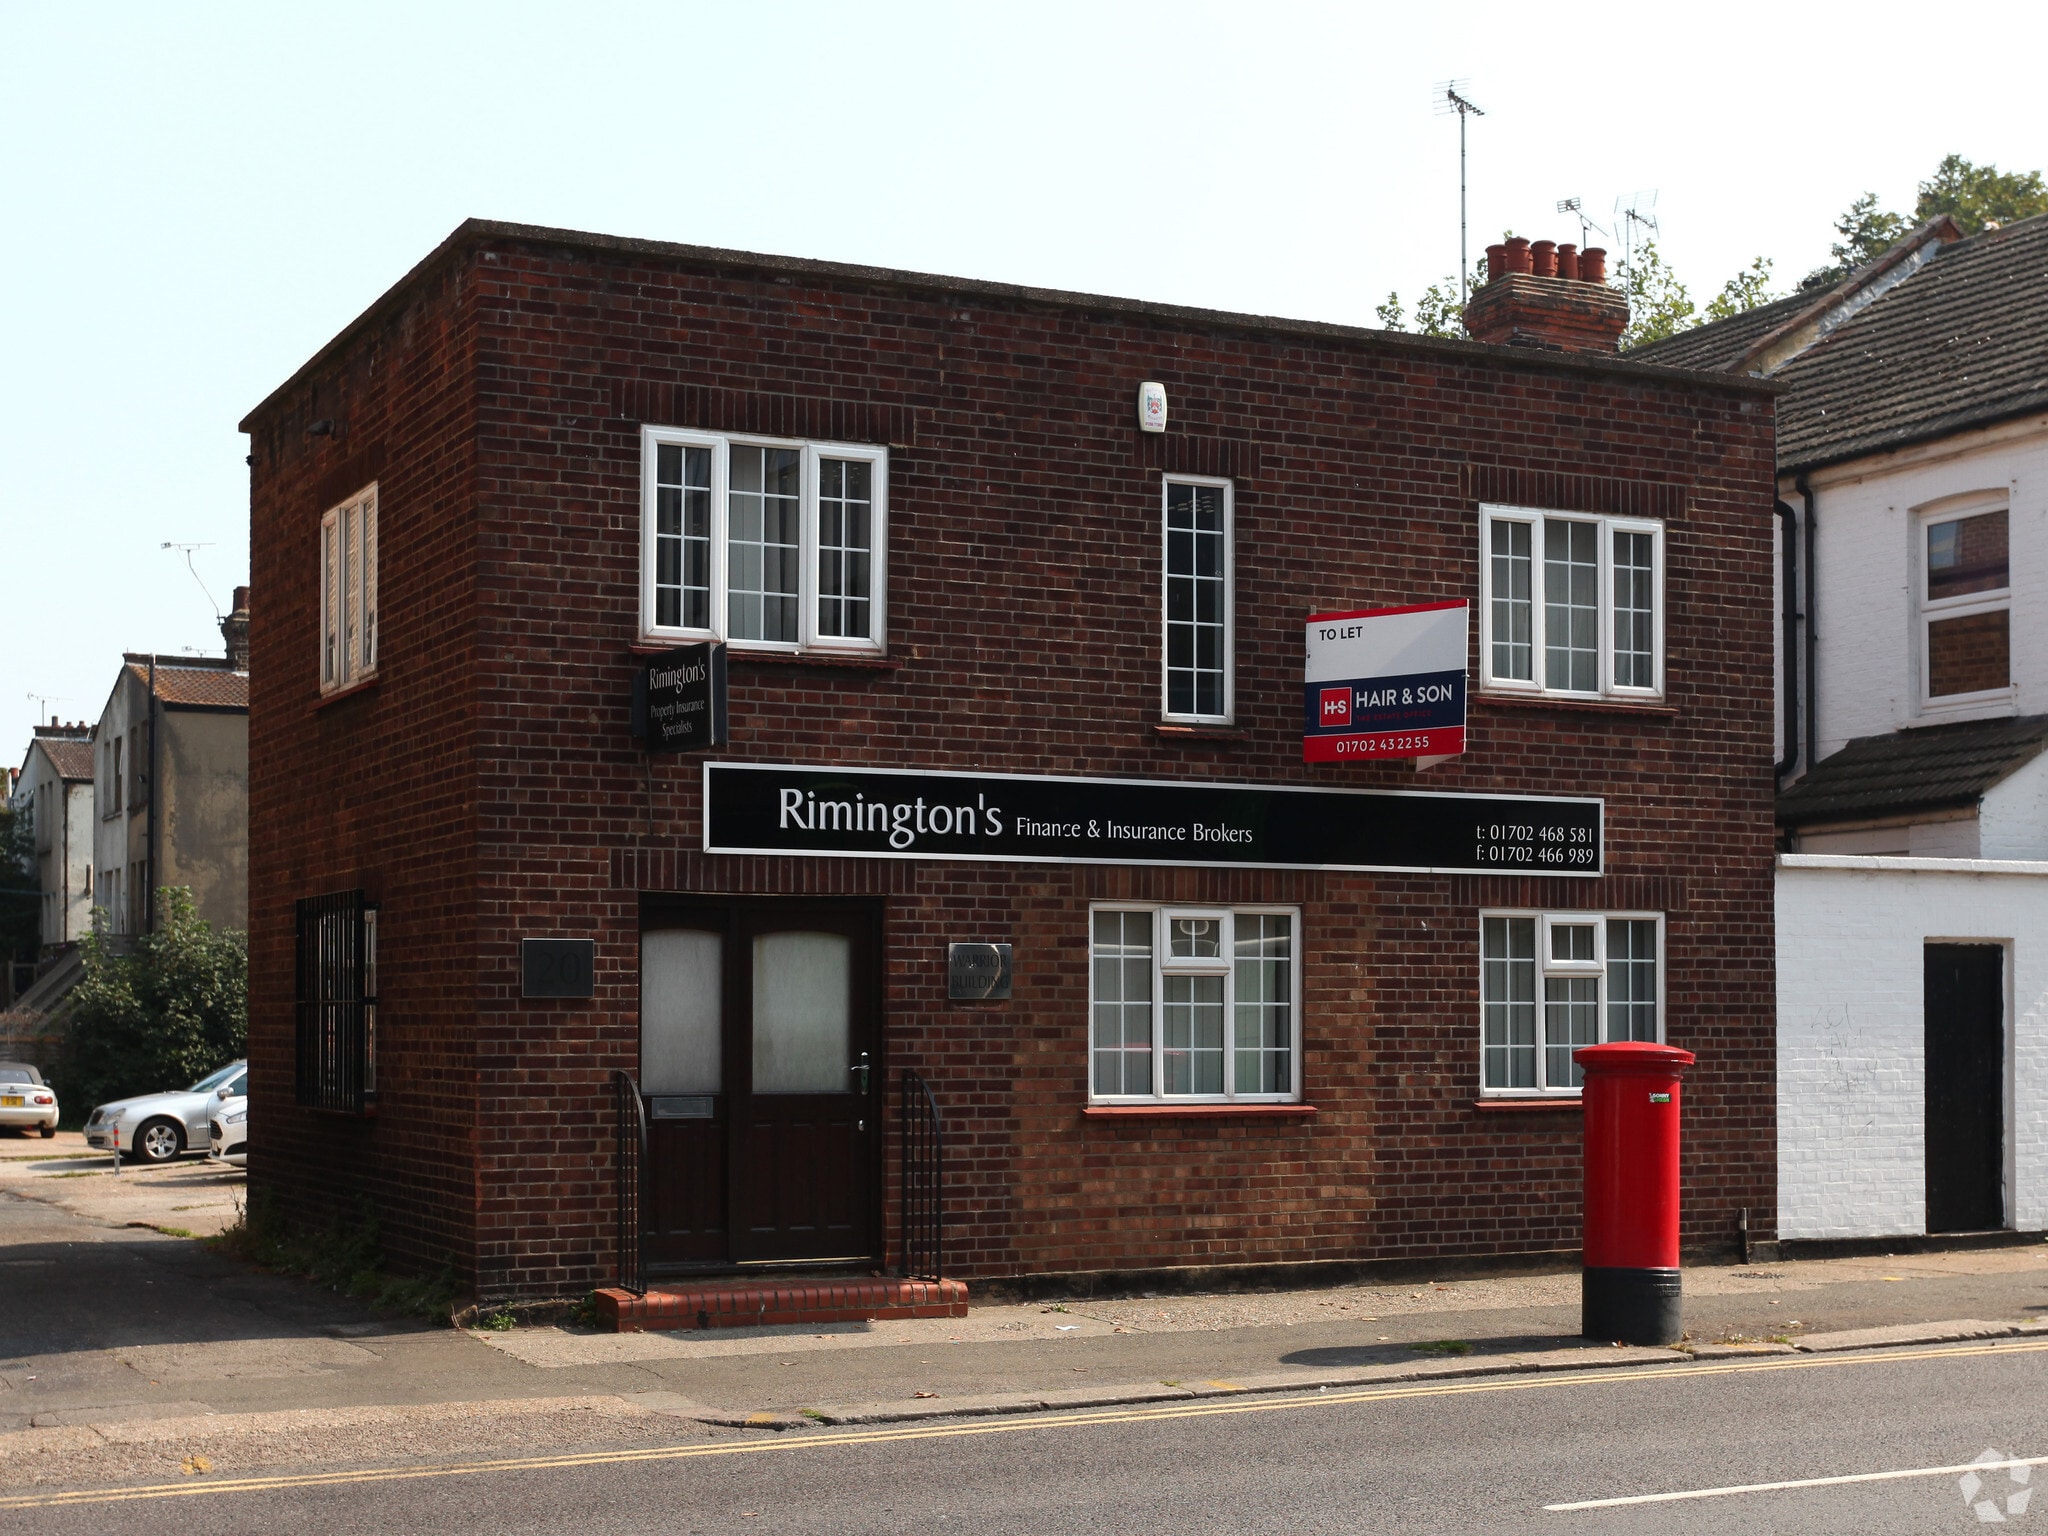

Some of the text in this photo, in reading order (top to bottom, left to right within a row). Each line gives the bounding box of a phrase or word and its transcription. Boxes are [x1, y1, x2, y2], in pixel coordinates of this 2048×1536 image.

[1319, 626, 1363, 641] TO LET
[649, 656, 706, 695] Rimington's
[1355, 684, 1452, 708] HAIR & SON
[650, 699, 705, 722] Property Insurance
[662, 719, 693, 742] Specialists
[1336, 739, 1376, 753] 01702
[779, 788, 1003, 849] Rimington's
[1016, 817, 1253, 843] Finance & Insurance Brokers
[1476, 824, 1592, 843] t: 01702 468 581
[1476, 844, 1594, 864] f: 01702 466 989
[953, 954, 1008, 968] WARRIOR
[951, 975, 1009, 989] BUILDING
